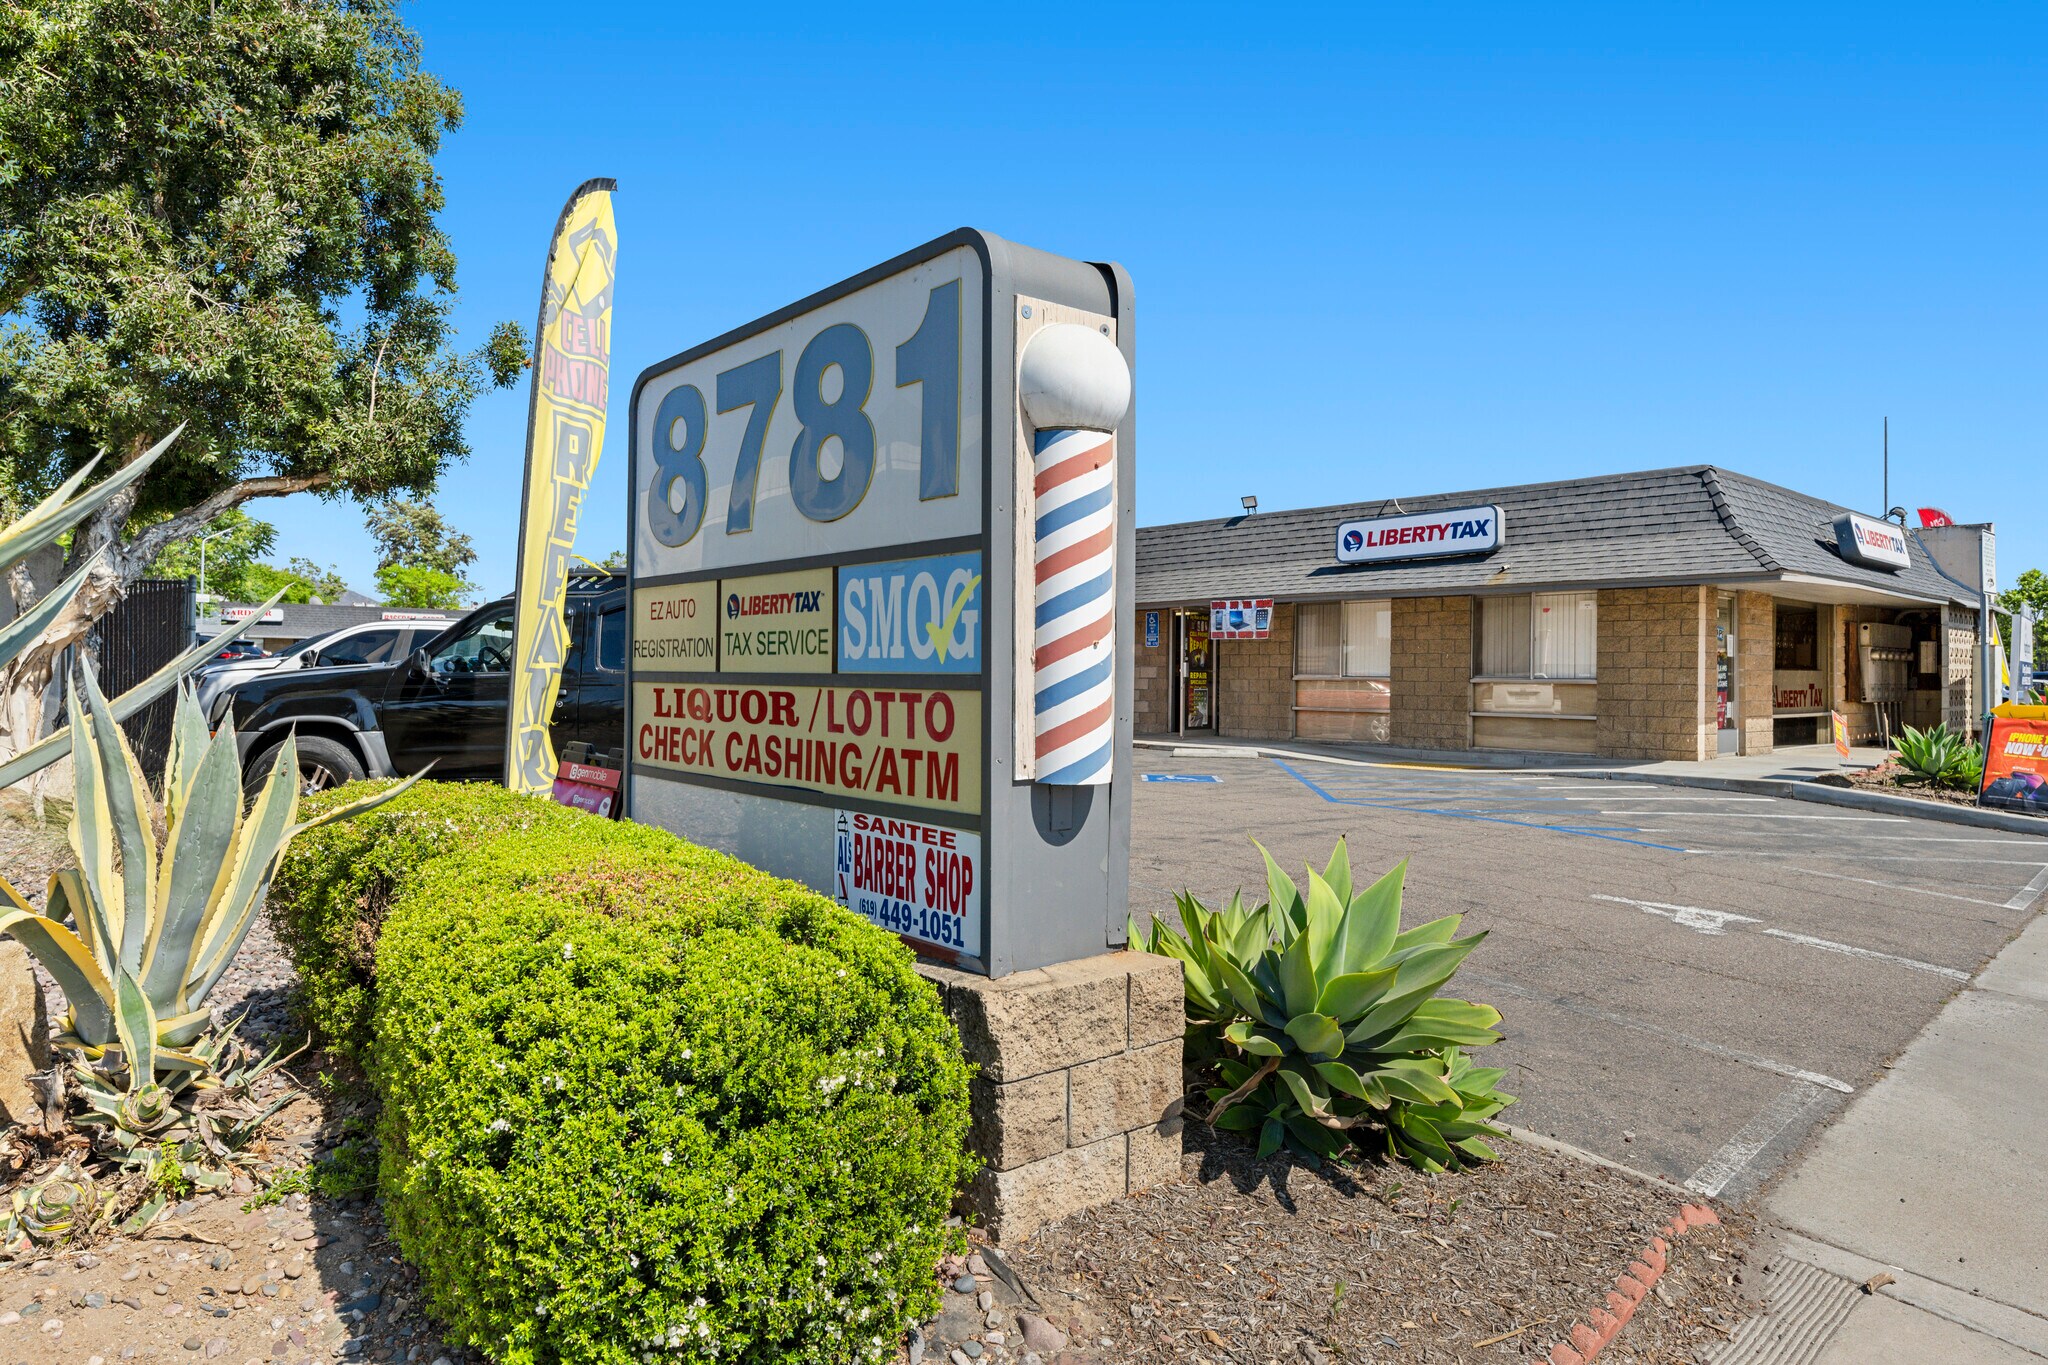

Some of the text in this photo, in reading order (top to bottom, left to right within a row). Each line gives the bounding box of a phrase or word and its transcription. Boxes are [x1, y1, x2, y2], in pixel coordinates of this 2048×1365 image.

[562, 309, 608, 366] CELL
[543, 341, 607, 413] PHONE
[648, 277, 962, 547] 8781
[221, 608, 271, 617] GARDR
[519, 414, 591, 795] REPAIR
[650, 598, 695, 620] EZ AUTO
[843, 568, 979, 660] SMOG
[634, 637, 714, 658] REGISTRATION
[725, 629, 829, 656] TAX SERVICE
[653, 688, 799, 727] LIQUOR
[1775, 684, 1823, 708] LIBERTY TAX
[639, 724, 959, 802] CHECK CASHING/ATM
[2004, 741, 2037, 756] NOW
[853, 813, 957, 850] SANTEE
[854, 833, 973, 917] BARBER SHOP
[859, 898, 965, 948] (619) 449-1051
